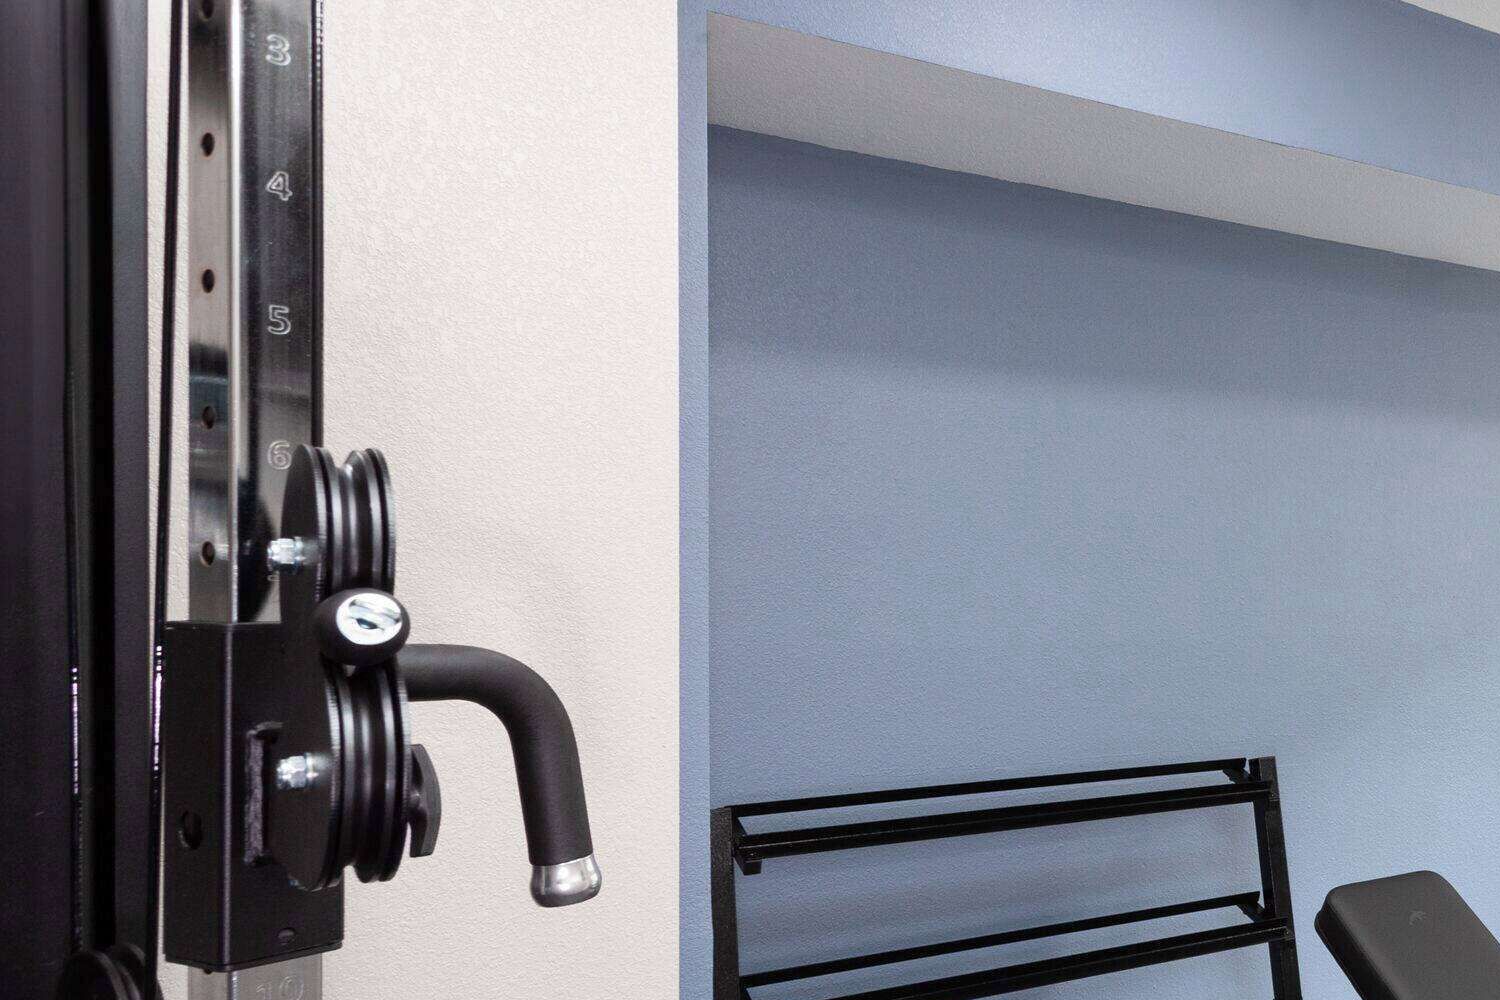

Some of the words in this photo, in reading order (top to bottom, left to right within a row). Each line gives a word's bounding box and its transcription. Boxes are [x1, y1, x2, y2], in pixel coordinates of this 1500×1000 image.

[265, 34, 292, 66] 3
[265, 171, 293, 201] 4
[267, 305, 292, 336] 5
[267, 440, 293, 470] 6
